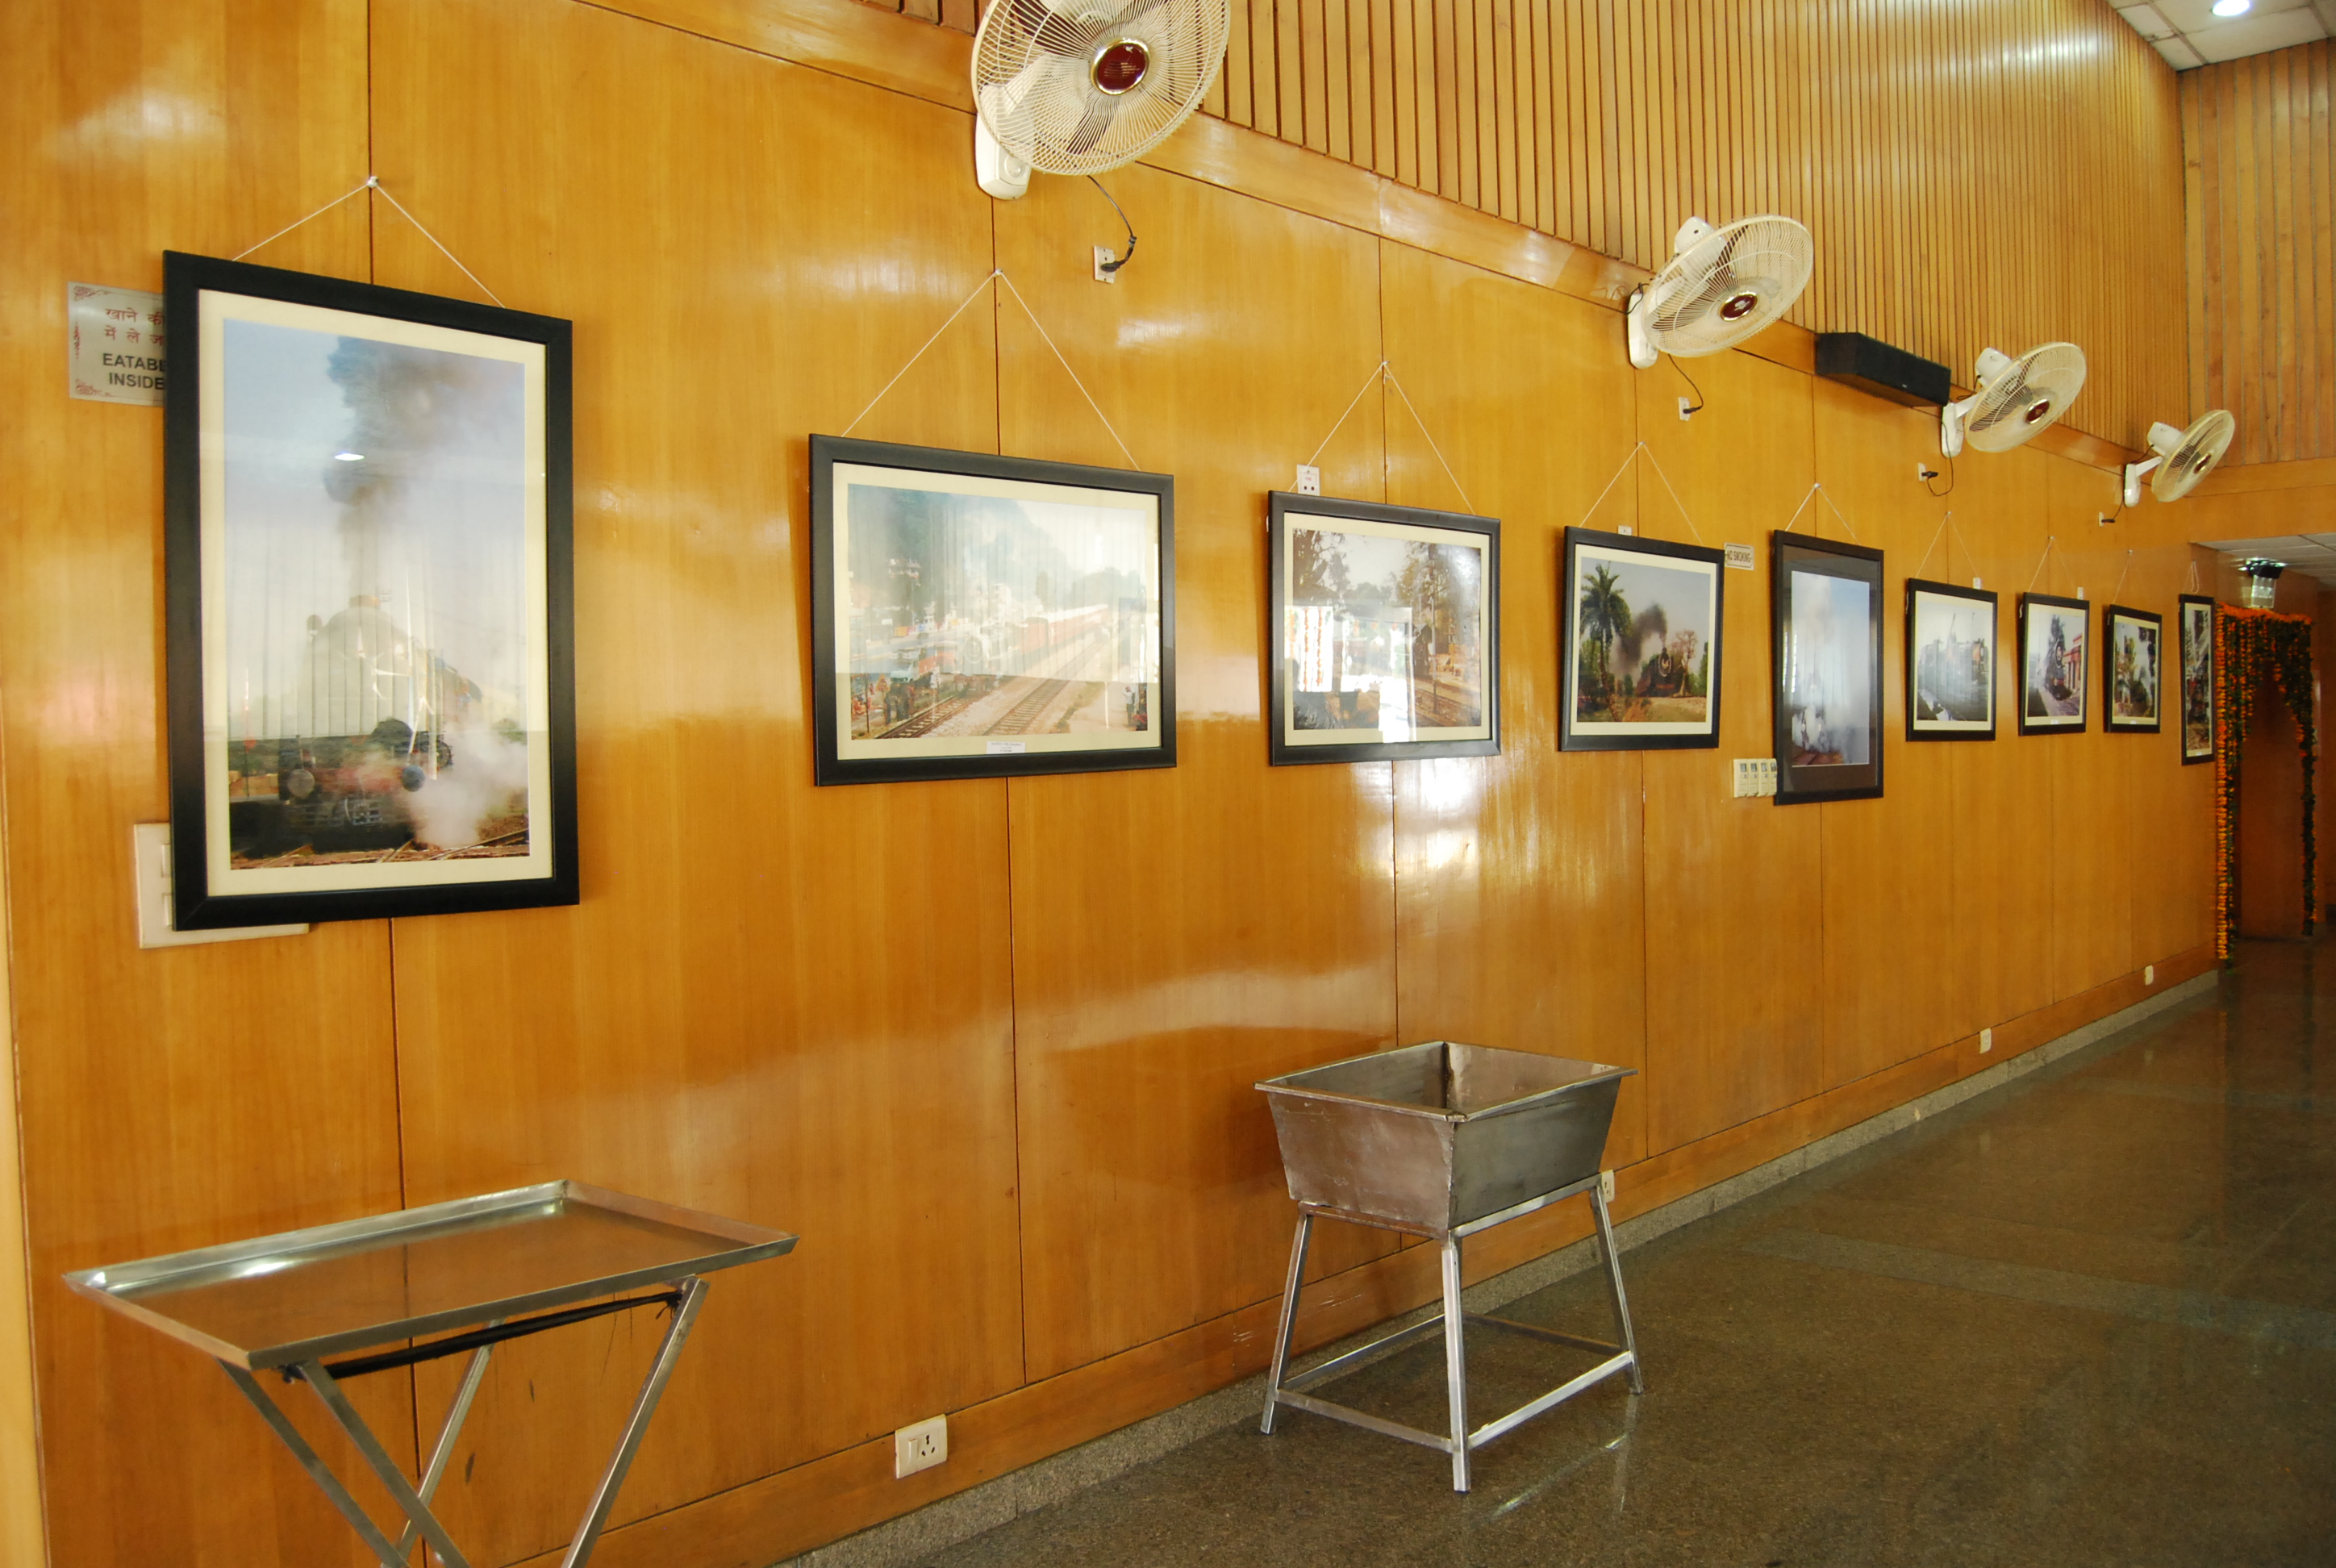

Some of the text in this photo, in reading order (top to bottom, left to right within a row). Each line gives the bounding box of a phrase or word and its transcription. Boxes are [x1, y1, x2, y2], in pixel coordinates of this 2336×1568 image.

[105, 307, 138, 323] खाने
[104, 325, 117, 340] में
[127, 327, 140, 344] ले
[109, 373, 165, 390] INSIDE
[1727, 550, 1750, 563] NO SMOKING
